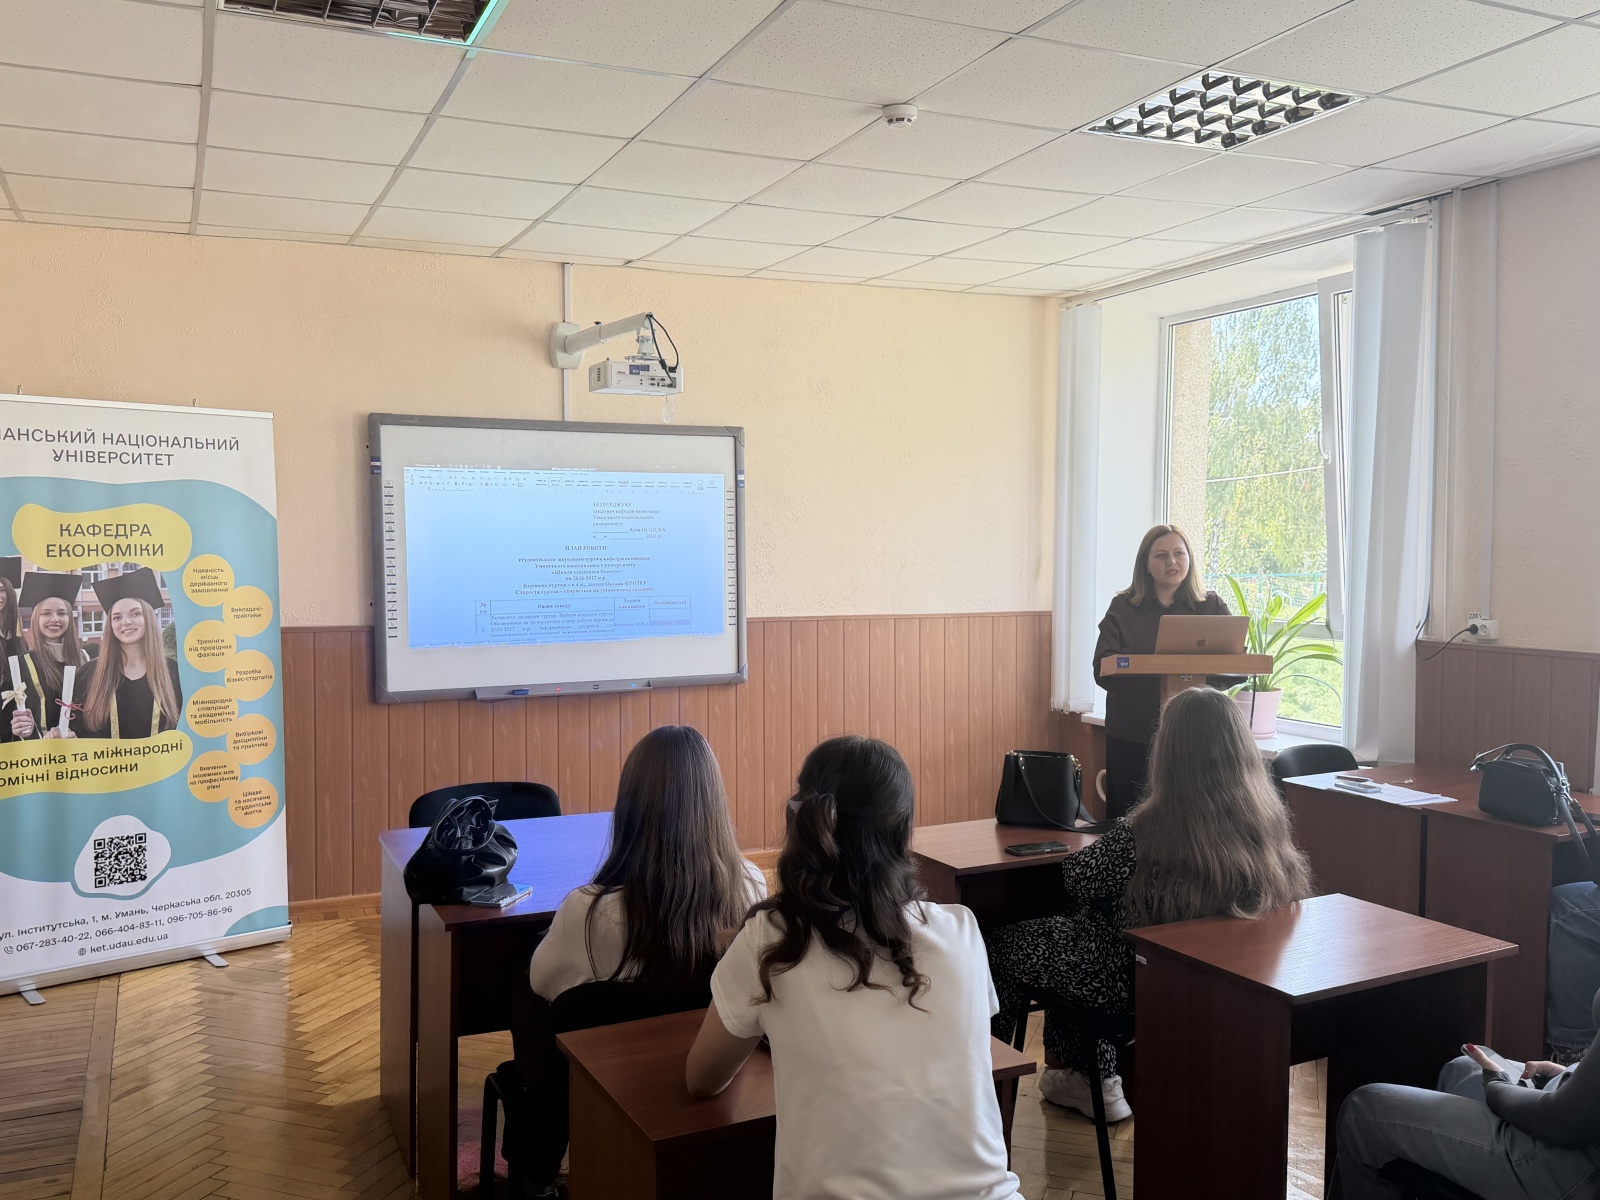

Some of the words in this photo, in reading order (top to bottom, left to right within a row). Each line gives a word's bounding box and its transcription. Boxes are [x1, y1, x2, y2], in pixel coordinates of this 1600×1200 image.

[0, 427, 96, 444] АНСЬКИЙ
[102, 432, 239, 451] НАЦІОНАЛЬНИЙ
[52, 449, 174, 466] УНІВЕРСИТЕТ
[59, 523, 152, 539] КАФЕДРА
[46, 543, 164, 558] ЕКОНОМІКИ
[226, 675, 274, 683] бізнес-стартапів
[192, 698, 233, 706] Міжнародна
[194, 717, 233, 725] мобільність
[232, 736, 268, 745] дисципліни
[71, 752, 89, 763] та
[93, 739, 183, 760] міжнародні
[55, 763, 139, 781] відносини
[192, 771, 223, 779] іноземних
[197, 775, 240, 785] професійному
[242, 795, 271, 803] насичене
[234, 801, 272, 811] студентське
[243, 809, 263, 817] життя
[17, 918, 90, 937] Інститутська,
[91, 915, 99, 923] 1,
[115, 908, 149, 919] Умань,
[151, 898, 202, 912] Черкаська
[203, 894, 223, 903] обл.
[225, 888, 252, 900] 20305
[15, 931, 93, 953] 067-283-40-22,
[94, 918, 165, 937] 066-404-83-11,
[166, 905, 233, 925] 096-705-86-96
[90, 933, 169, 953] ket.udau.edu.ua
